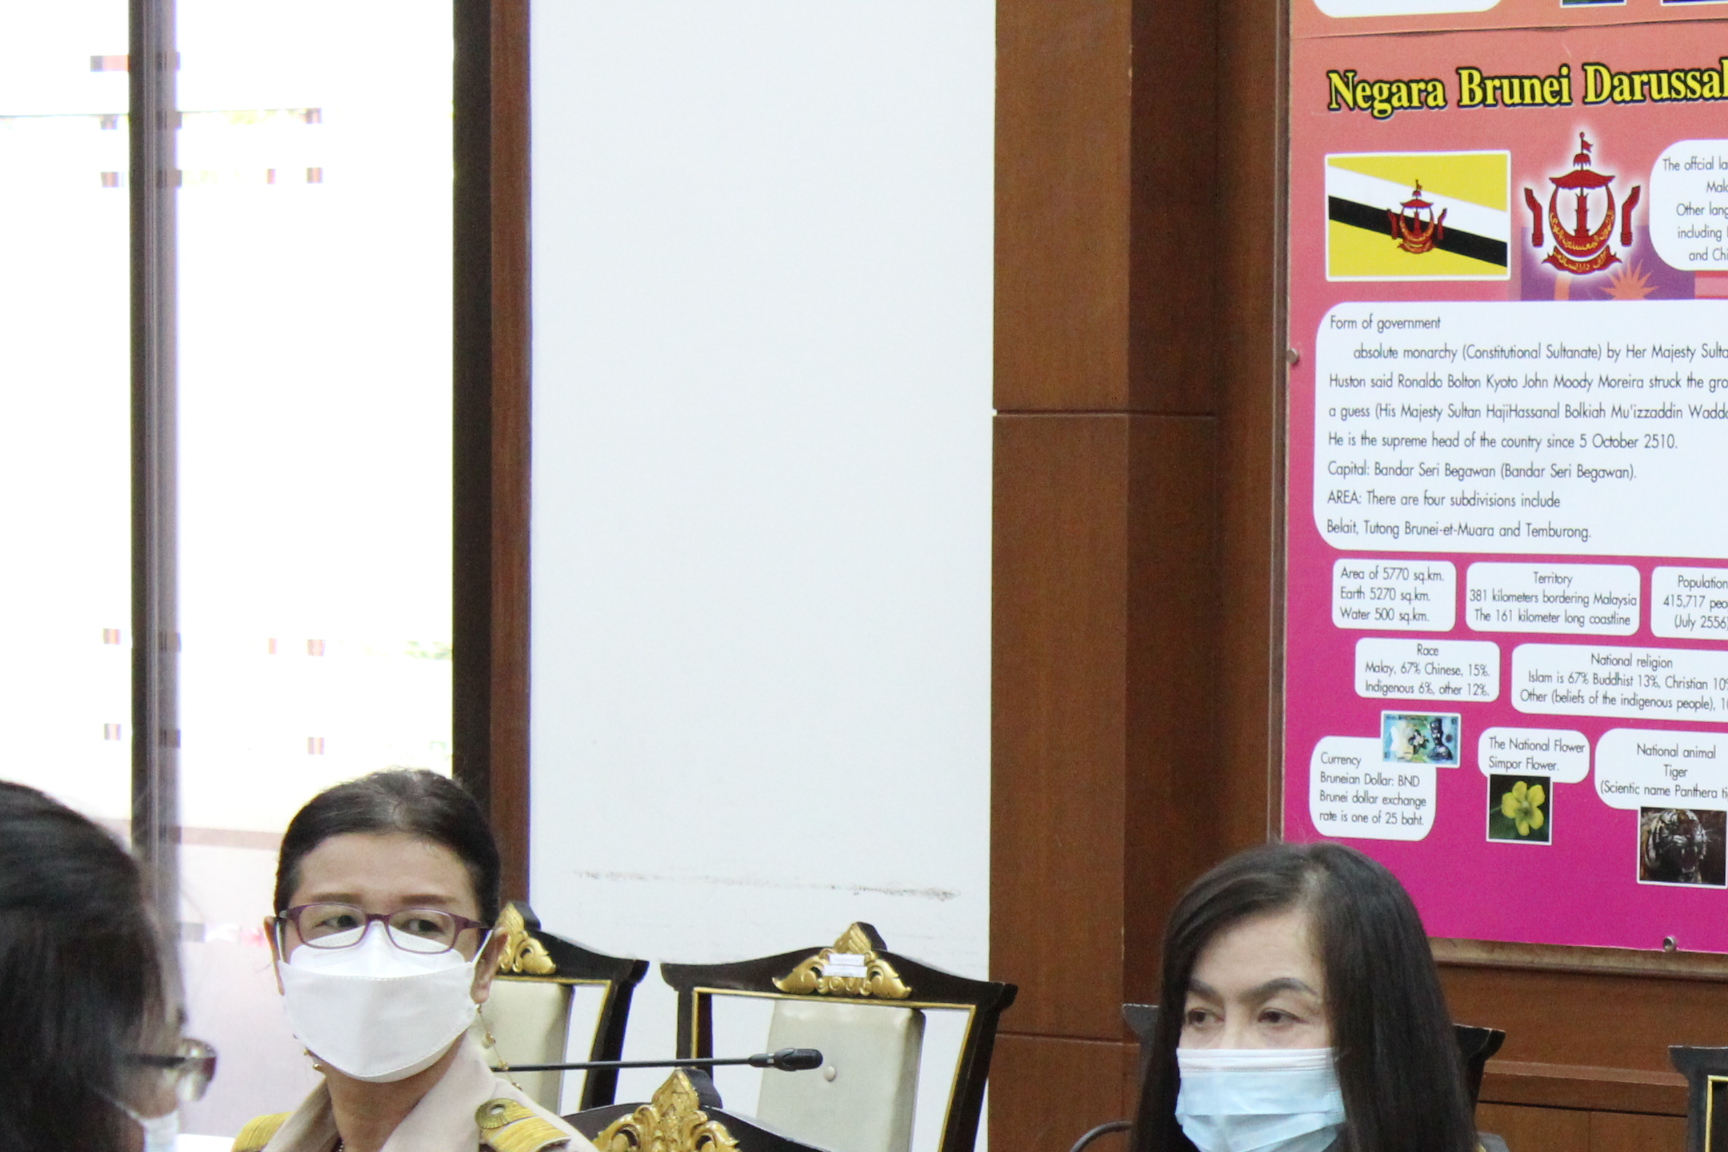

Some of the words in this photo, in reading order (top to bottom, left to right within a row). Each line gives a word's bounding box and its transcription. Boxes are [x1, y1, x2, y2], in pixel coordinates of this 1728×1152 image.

[1328, 71, 1446, 117] Negara
[1459, 66, 1572, 107] Brunei
[1675, 201, 1705, 217] Other
[1677, 223, 1723, 243] including
[1688, 246, 1709, 262] and
[1330, 314, 1358, 330] Form
[1361, 312, 1374, 330] of
[1376, 316, 1441, 335] government
[1353, 342, 1399, 360] absolute
[1403, 342, 1458, 364] monarchy
[1462, 342, 1541, 361] (Constitutional
[1545, 342, 1602, 362] Sultanate)
[1606, 342, 1622, 364] by
[1626, 344, 1647, 359] Her
[1651, 344, 1697, 363] Majesty
[1327, 459, 1370, 480] Capital:
[1374, 459, 1415, 477] Bandar
[1418, 461, 1440, 477] Seri
[1444, 462, 1496, 482] Begawan
[1500, 461, 1546, 480] (Bandar
[1550, 462, 1572, 479] Seri
[1576, 463, 1637, 484] Begawan).
[1326, 517, 1359, 535] Belait,
[1365, 519, 1400, 540] Tutong
[1404, 520, 1495, 537] Brunei-et-Muara
[1498, 521, 1521, 538] and
[1527, 521, 1592, 543] Temburong.
[1677, 574, 1728, 592] Population
[1662, 594, 1706, 609] 415,717
[1674, 613, 1697, 632] (July
[1590, 652, 1633, 667] National
[1636, 653, 1673, 672] religion
[1488, 735, 1506, 751] The
[1509, 737, 1550, 752] National
[1553, 736, 1586, 753] Flower
[1636, 742, 1679, 758] National
[1682, 744, 1716, 760] animal
[1488, 755, 1523, 773] Simpor
[1525, 755, 1559, 772] Flower.
[1663, 763, 1689, 782] Tiger
